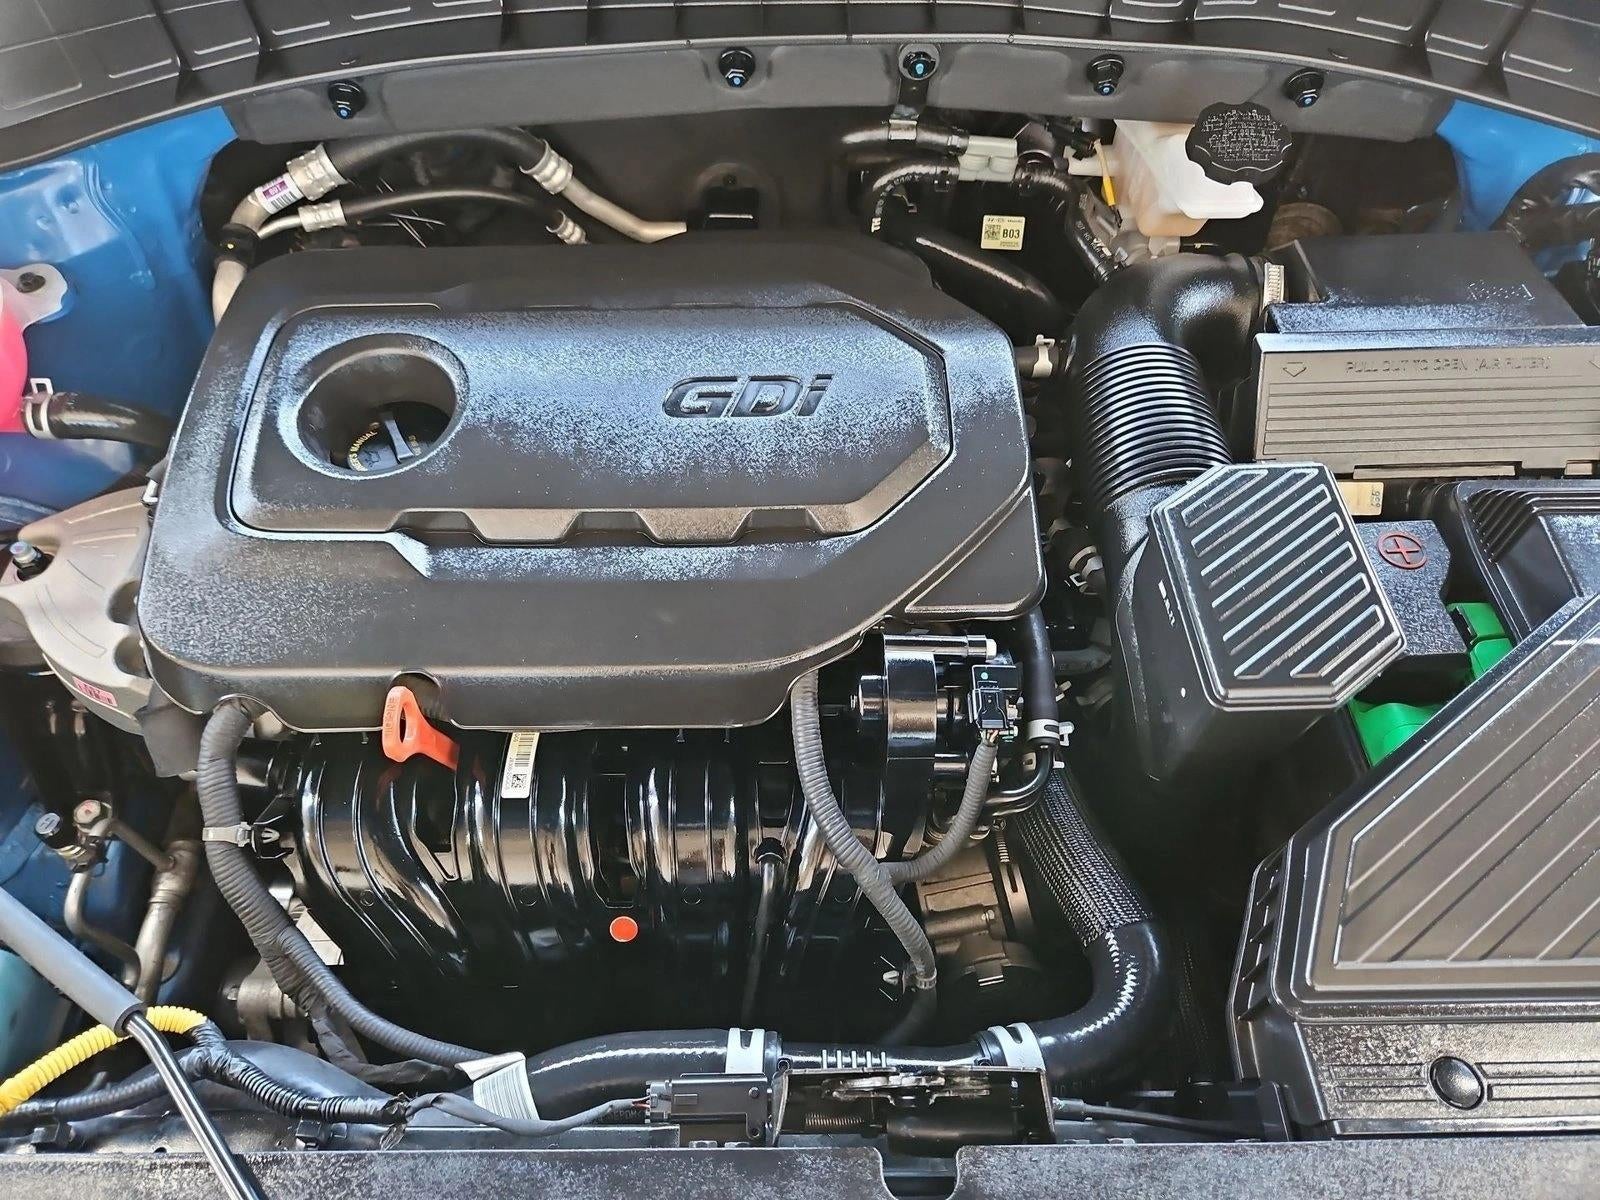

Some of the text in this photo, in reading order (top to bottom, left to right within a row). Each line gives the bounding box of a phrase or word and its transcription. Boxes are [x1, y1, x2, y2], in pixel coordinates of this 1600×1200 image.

[1002, 228, 1021, 239] B03
[1433, 358, 1467, 370] OPEN
[662, 373, 835, 418] GDi
[349, 430, 378, 452] MANUAL
